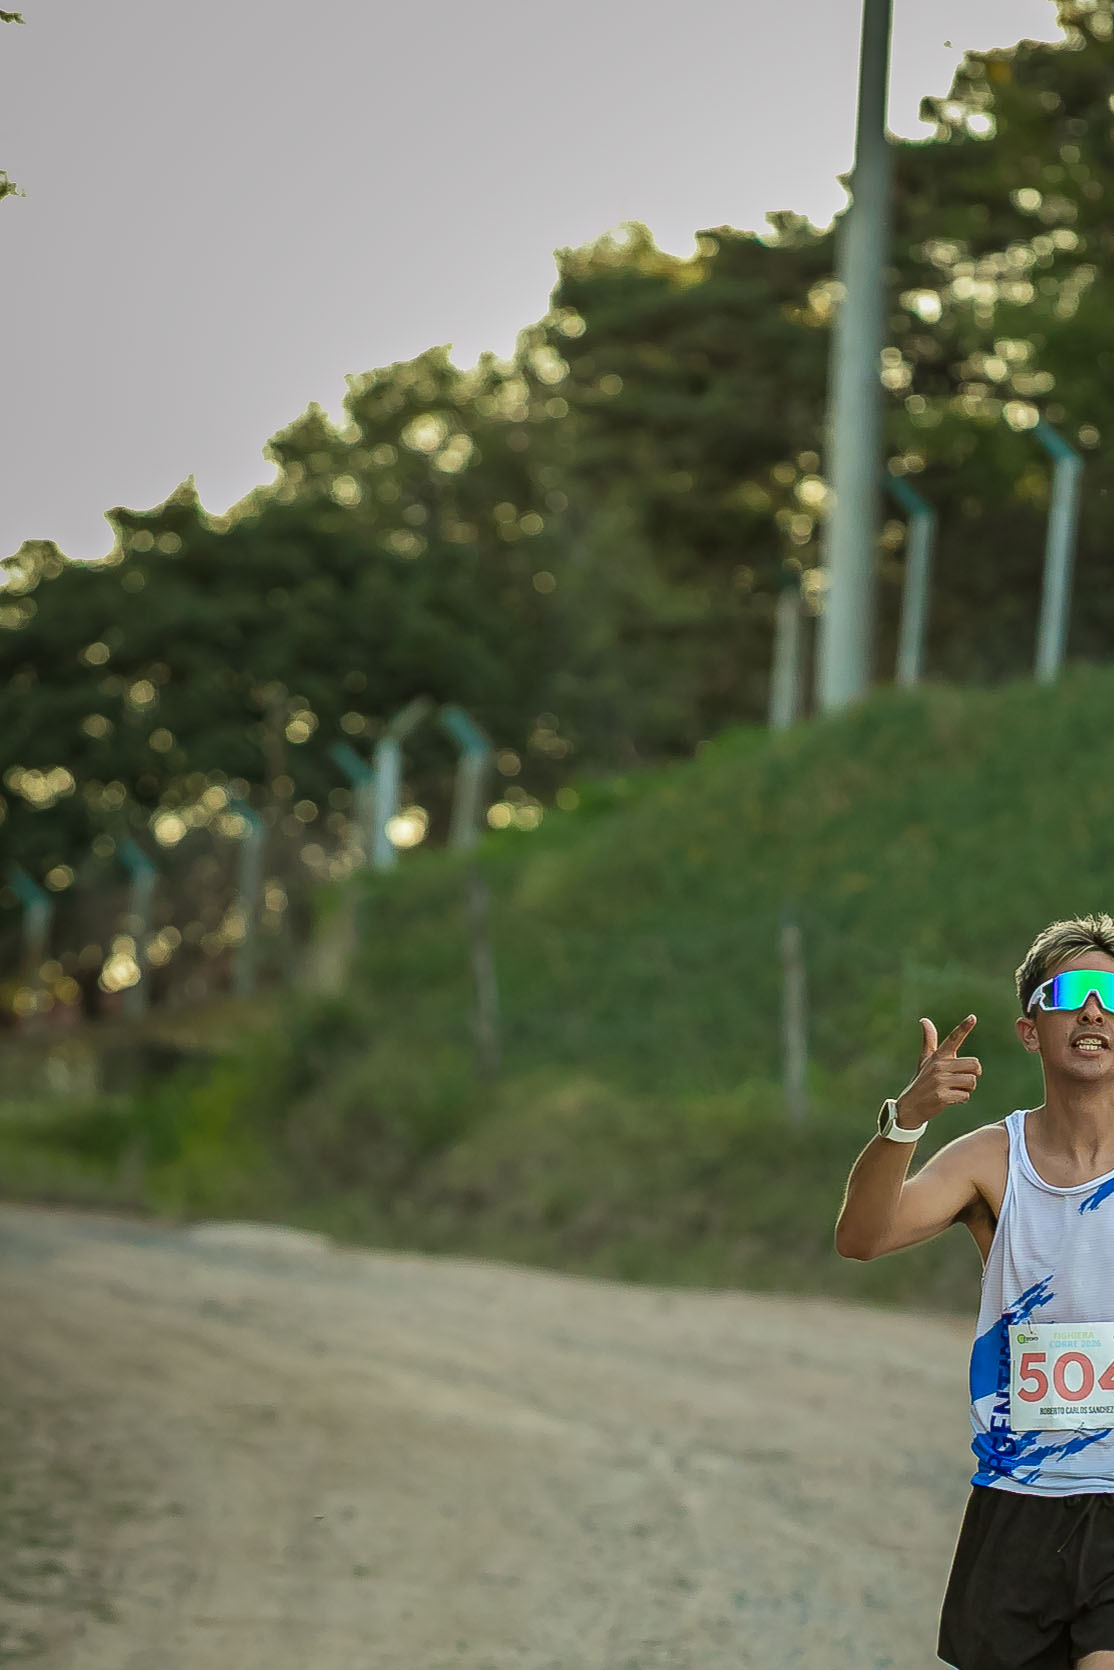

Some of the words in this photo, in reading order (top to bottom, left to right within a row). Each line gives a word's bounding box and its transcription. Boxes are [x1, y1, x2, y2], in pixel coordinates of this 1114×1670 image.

[1040, 1407, 1064, 1415] ROBERTO
[1066, 1406, 1087, 1414] CARLOS
[1089, 1405, 1114, 1414] SANCHEZ
